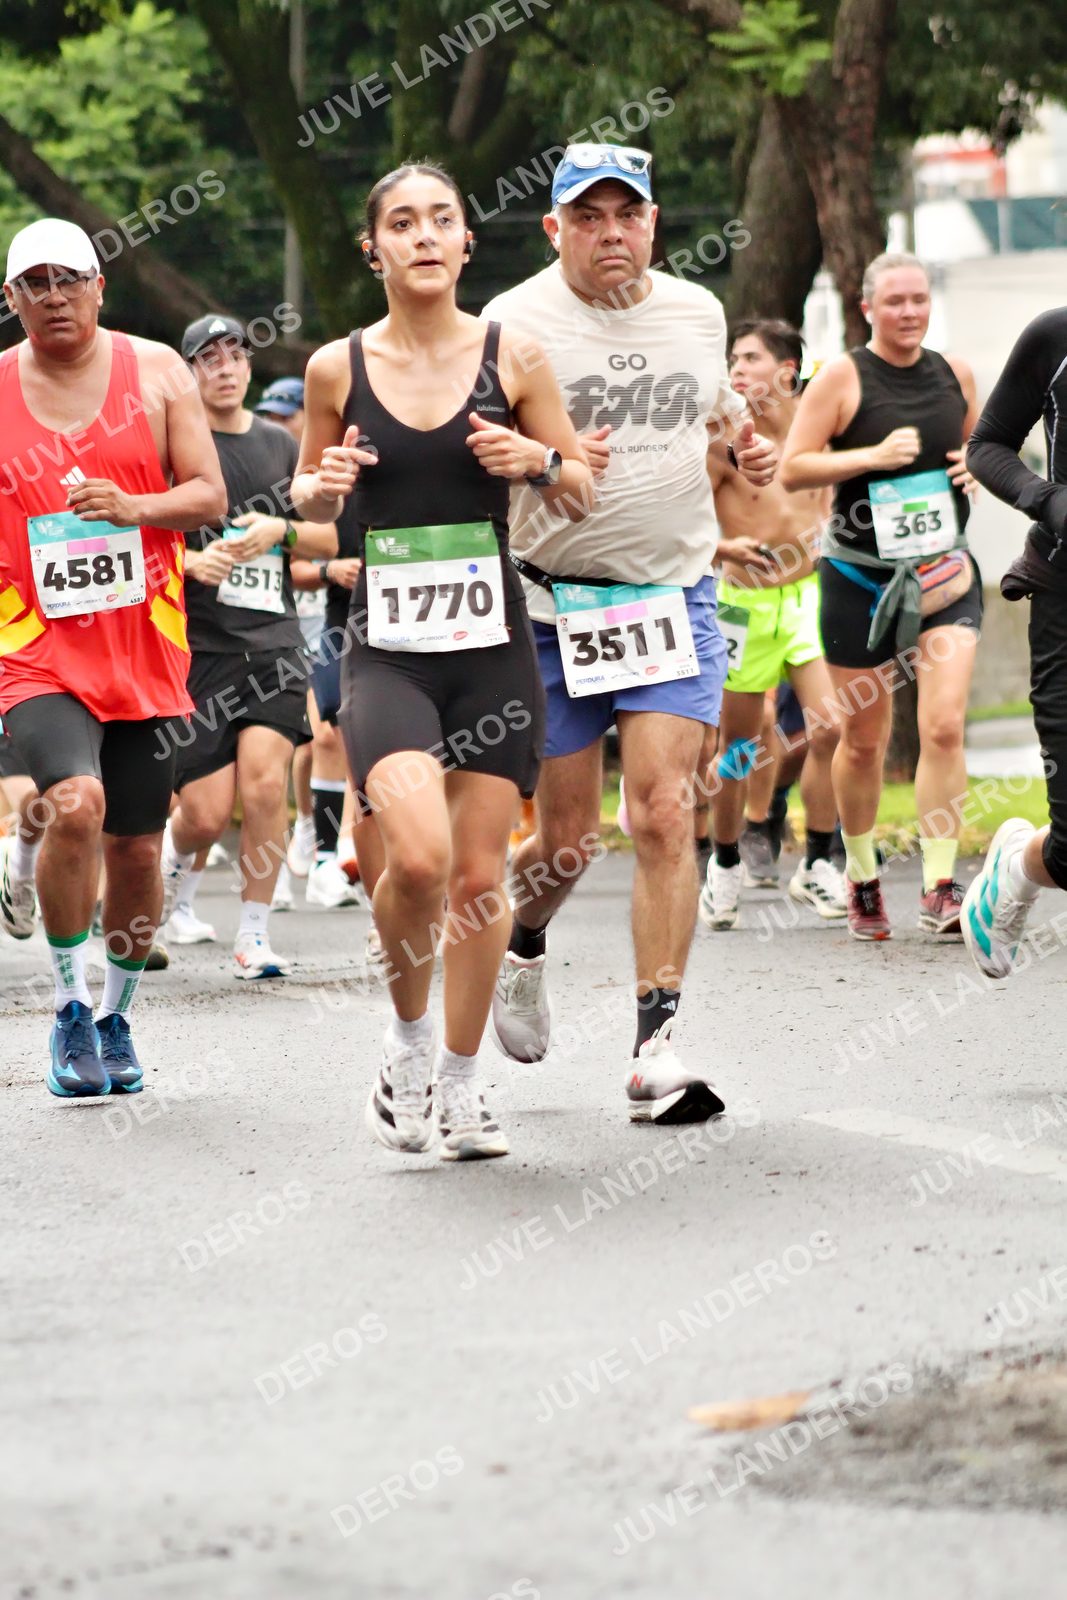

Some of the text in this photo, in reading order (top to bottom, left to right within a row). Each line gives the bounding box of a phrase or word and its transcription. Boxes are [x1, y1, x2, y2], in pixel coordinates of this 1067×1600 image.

[608, 353, 647, 371] GO
[627, 444, 668, 454] RUNNERS
[891, 510, 941, 539] 363
[43, 551, 133, 592] 4581
[228, 565, 281, 592] 6513
[382, 581, 493, 624] 1770
[569, 617, 676, 666] 3511
[630, 1072, 643, 1089] N
